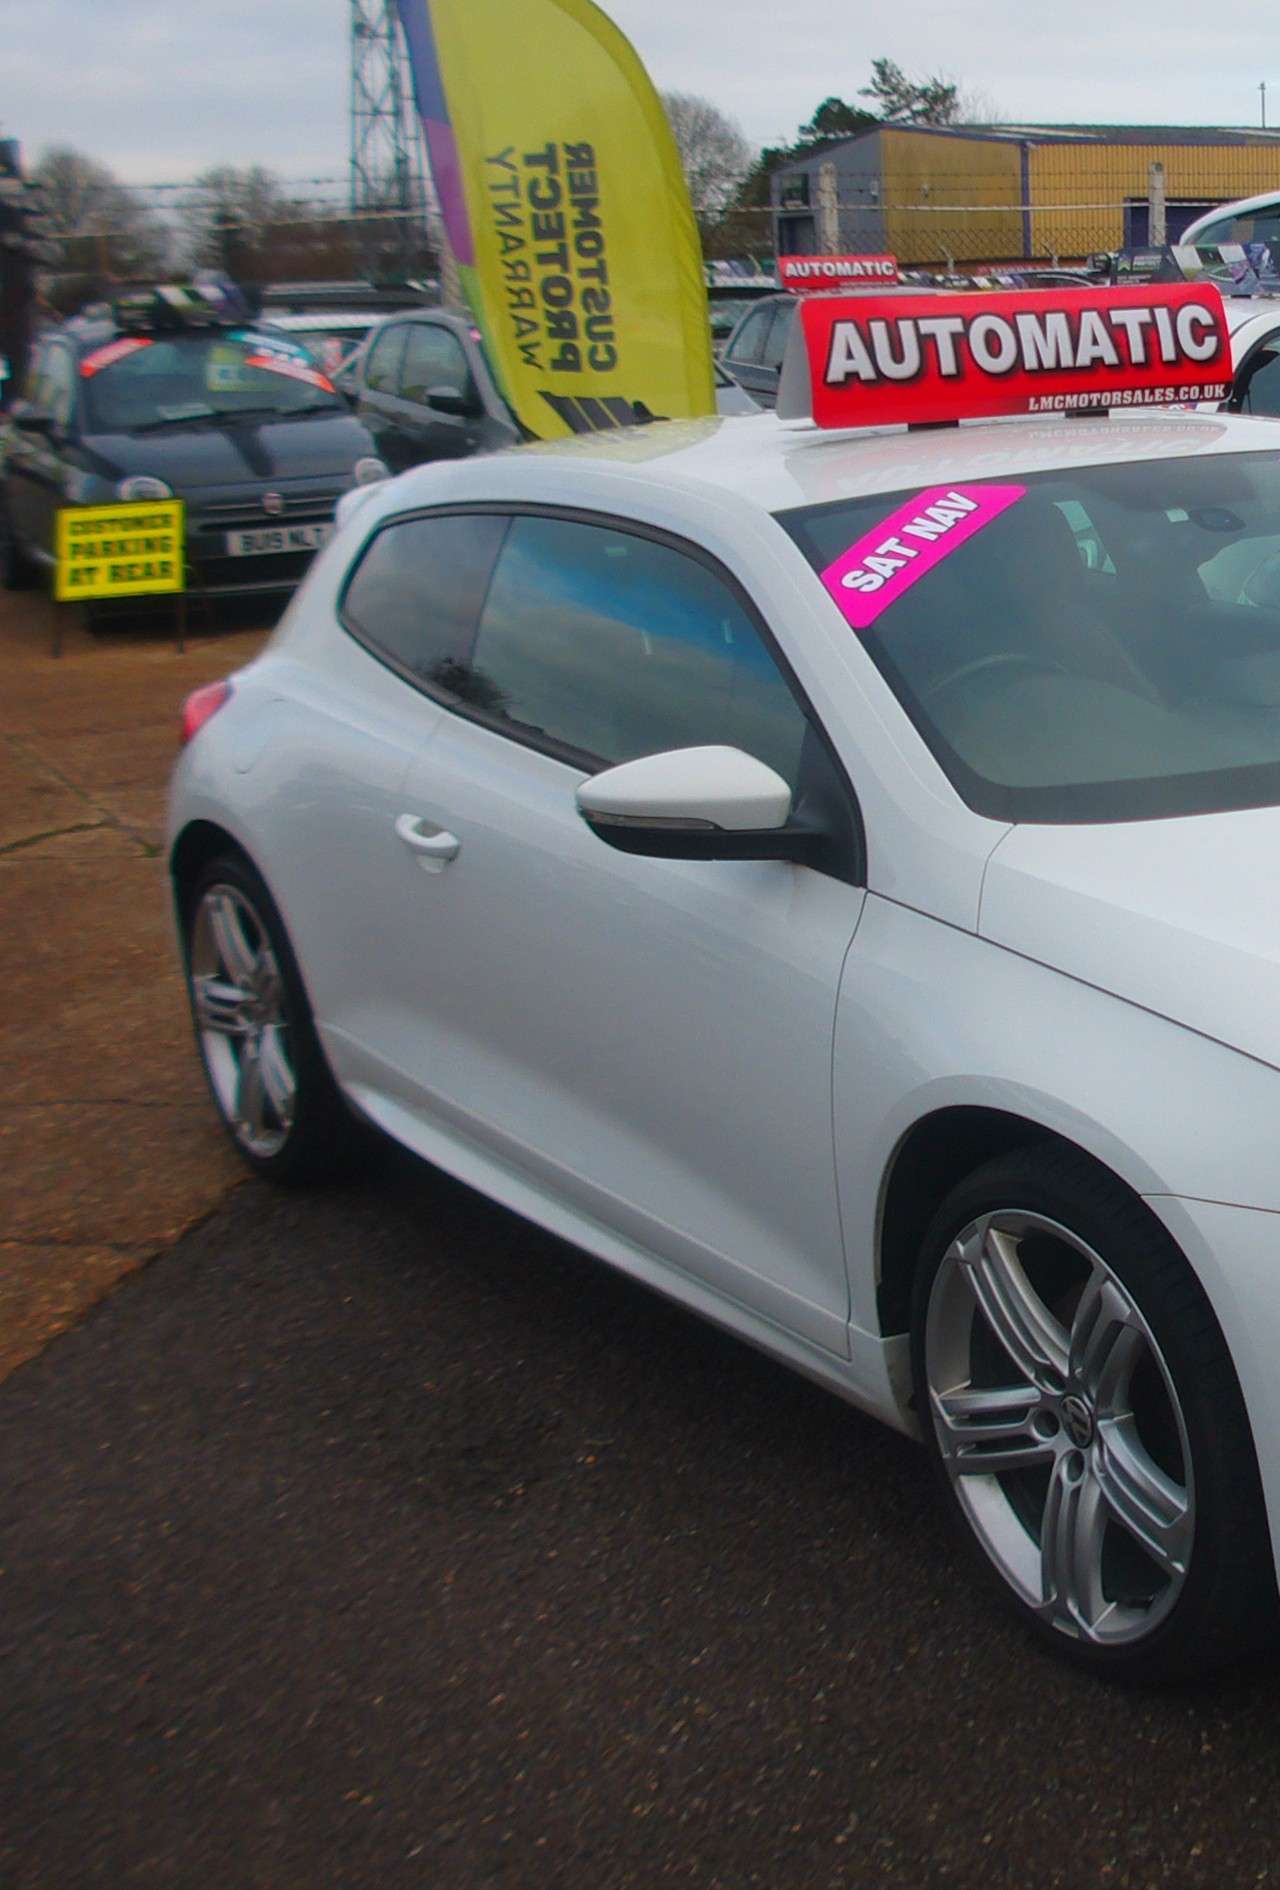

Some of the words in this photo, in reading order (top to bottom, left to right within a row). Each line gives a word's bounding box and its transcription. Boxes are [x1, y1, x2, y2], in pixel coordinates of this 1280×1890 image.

[784, 261, 895, 277] AUTOMATIC
[825, 304, 1219, 384] AUTOMATIC
[1029, 384, 1226, 412] LMCMOTORSALES.CO.UK
[68, 536, 173, 560] PARKING
[841, 537, 919, 592] SAT
[901, 491, 979, 541] NAV
[68, 566, 98, 586] AT
[107, 561, 173, 582] REAR
